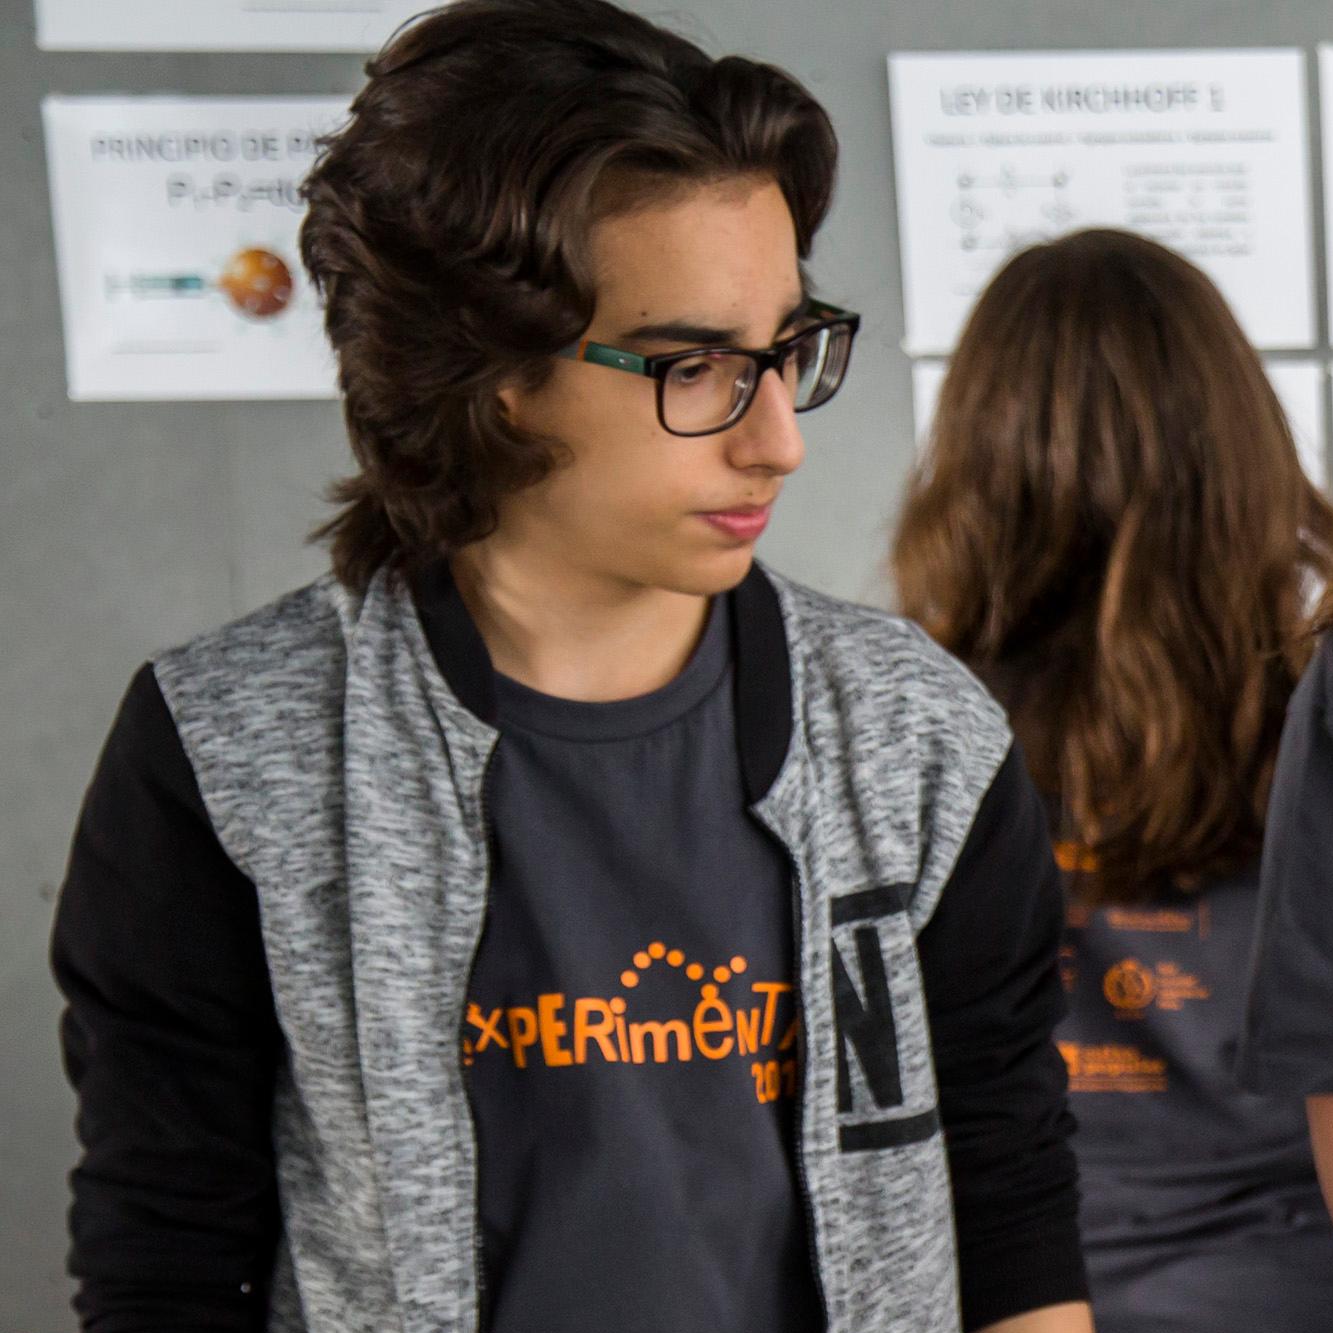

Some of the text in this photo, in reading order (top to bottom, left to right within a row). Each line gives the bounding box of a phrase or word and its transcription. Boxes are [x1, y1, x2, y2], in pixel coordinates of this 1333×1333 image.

[939, 82, 992, 116] LEY
[994, 82, 1036, 115] DE
[1040, 81, 1199, 114] KIRCHHOFF
[91, 128, 238, 162] PRINCIPIO
[241, 128, 280, 162] DE
